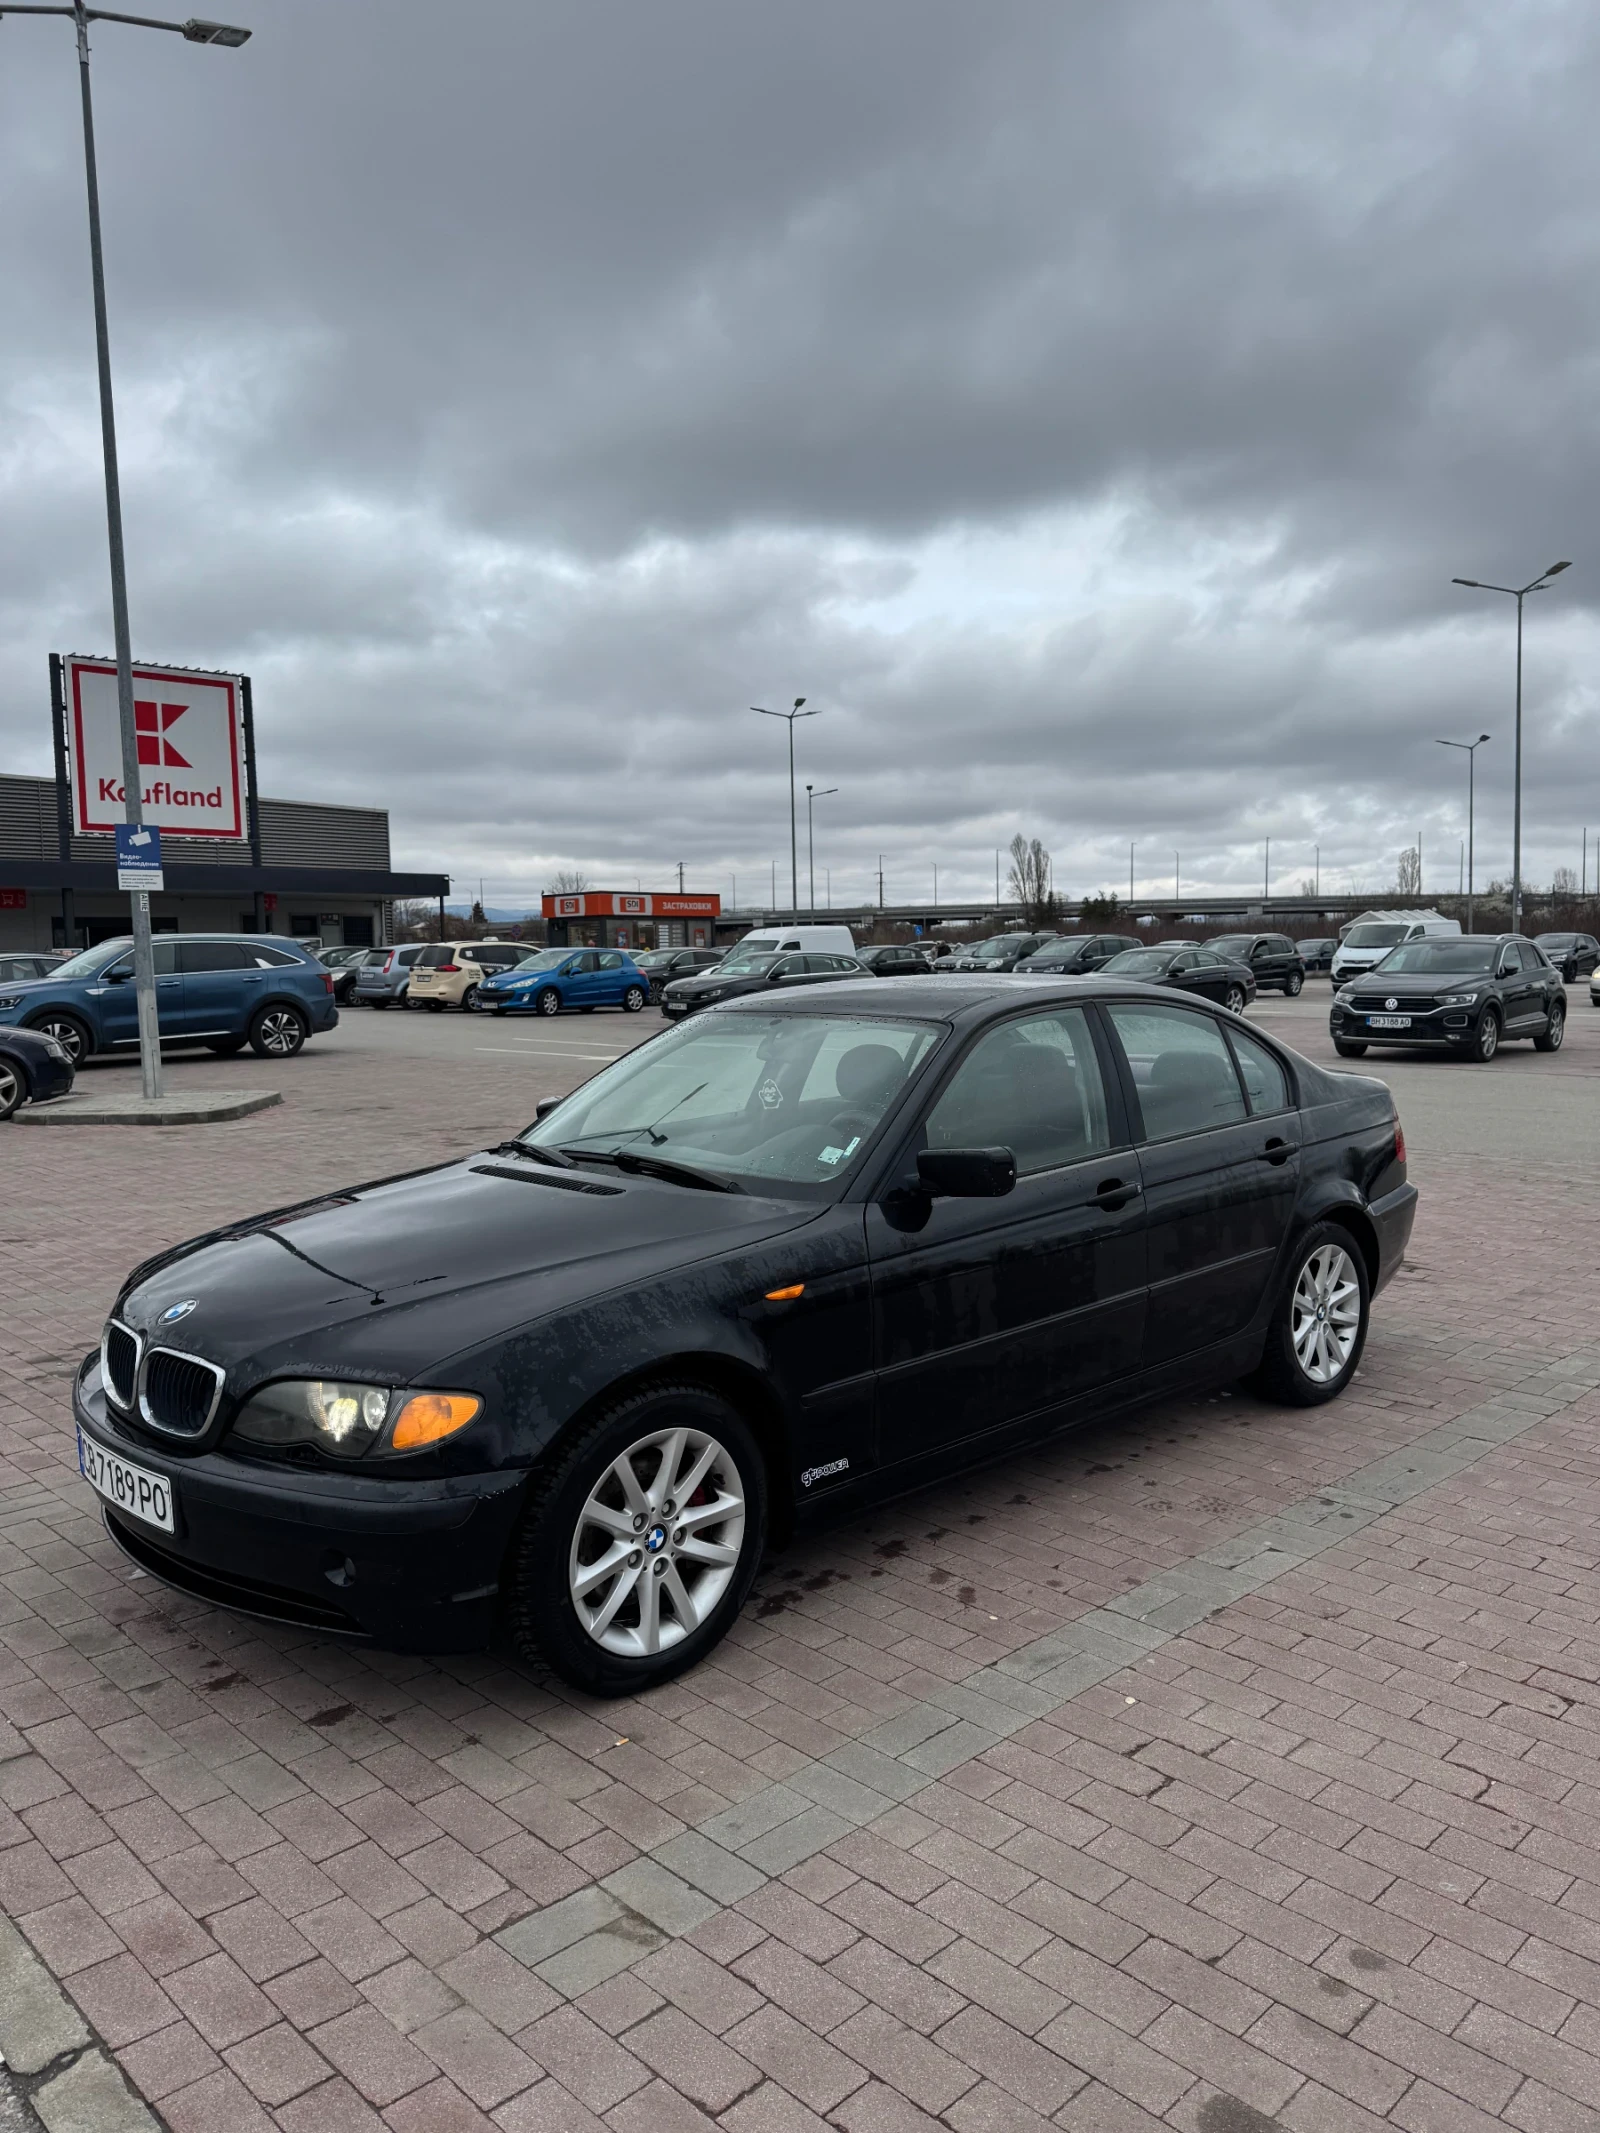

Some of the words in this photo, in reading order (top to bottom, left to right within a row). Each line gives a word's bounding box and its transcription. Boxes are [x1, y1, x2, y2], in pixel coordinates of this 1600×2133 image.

[120, 860, 160, 868] наблюдение
[565, 901, 574, 909] SDI
[627, 900, 638, 908] SDI
[662, 901, 712, 910] ЗАСТРАХОВКИ
